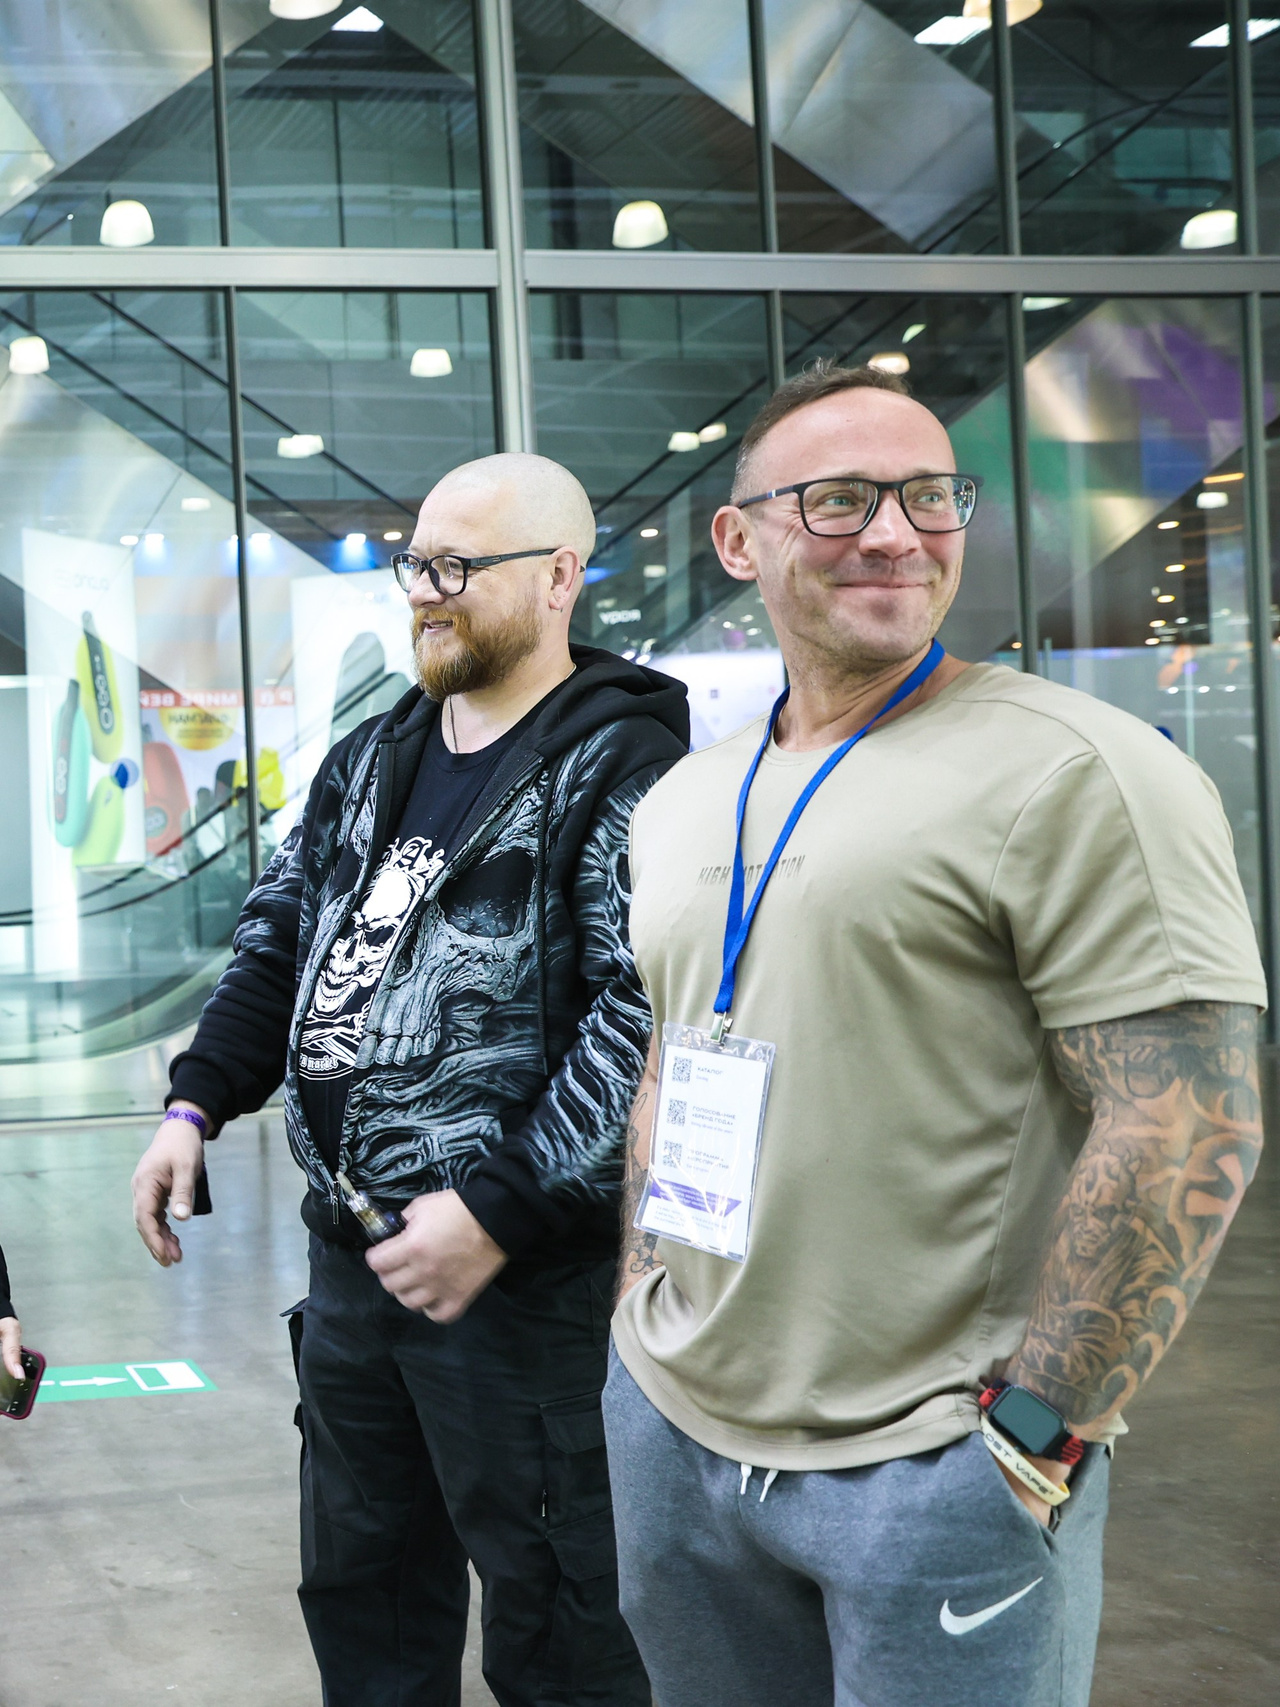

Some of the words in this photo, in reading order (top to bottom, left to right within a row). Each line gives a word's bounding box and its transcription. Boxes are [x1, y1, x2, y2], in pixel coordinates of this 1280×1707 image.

[696, 865, 732, 886] HIGH
[692, 1105, 737, 1120] ГОЛОСОВНИЕ
[984, 1433, 1012, 1459] OST
